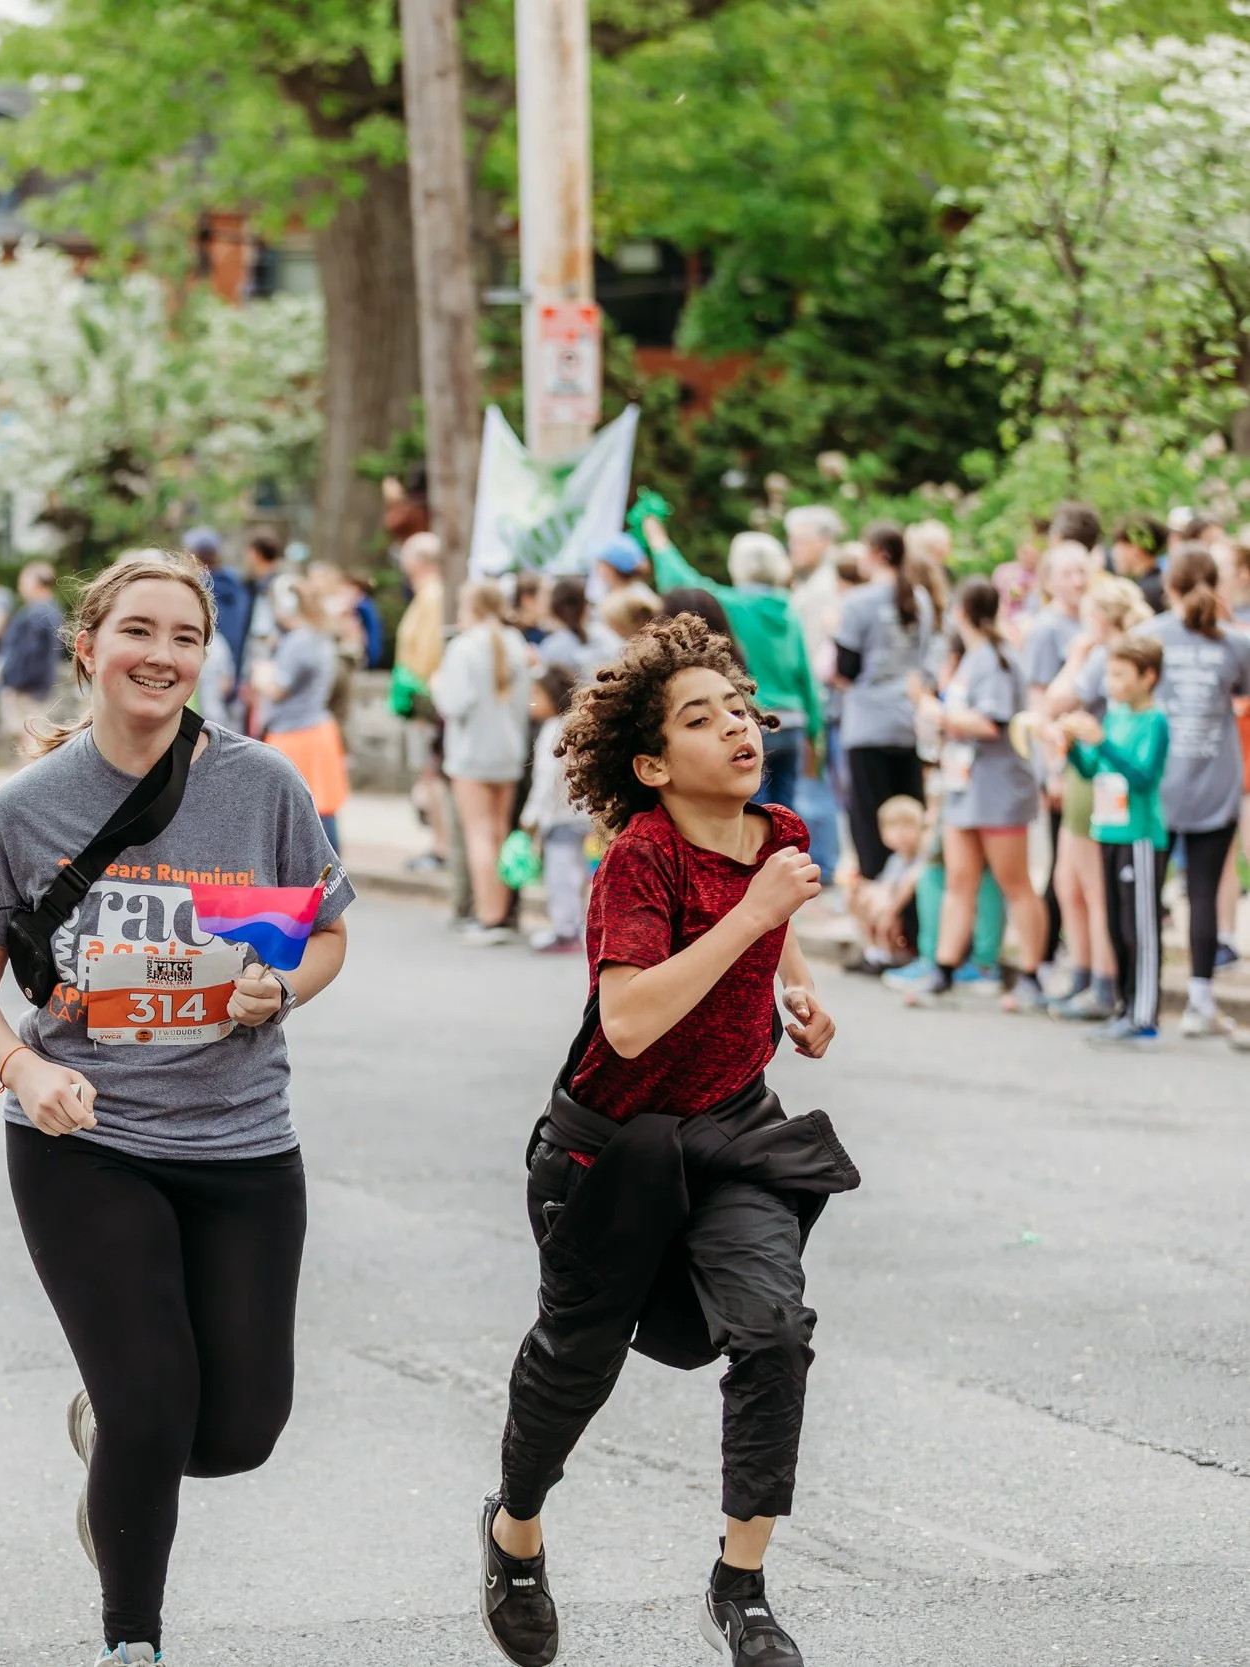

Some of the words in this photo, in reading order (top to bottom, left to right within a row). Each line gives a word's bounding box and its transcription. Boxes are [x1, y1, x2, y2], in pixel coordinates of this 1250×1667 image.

[104, 863, 151, 881] ears
[157, 863, 255, 888] Running!
[80, 891, 237, 947] rac
[126, 992, 207, 1024] 314
